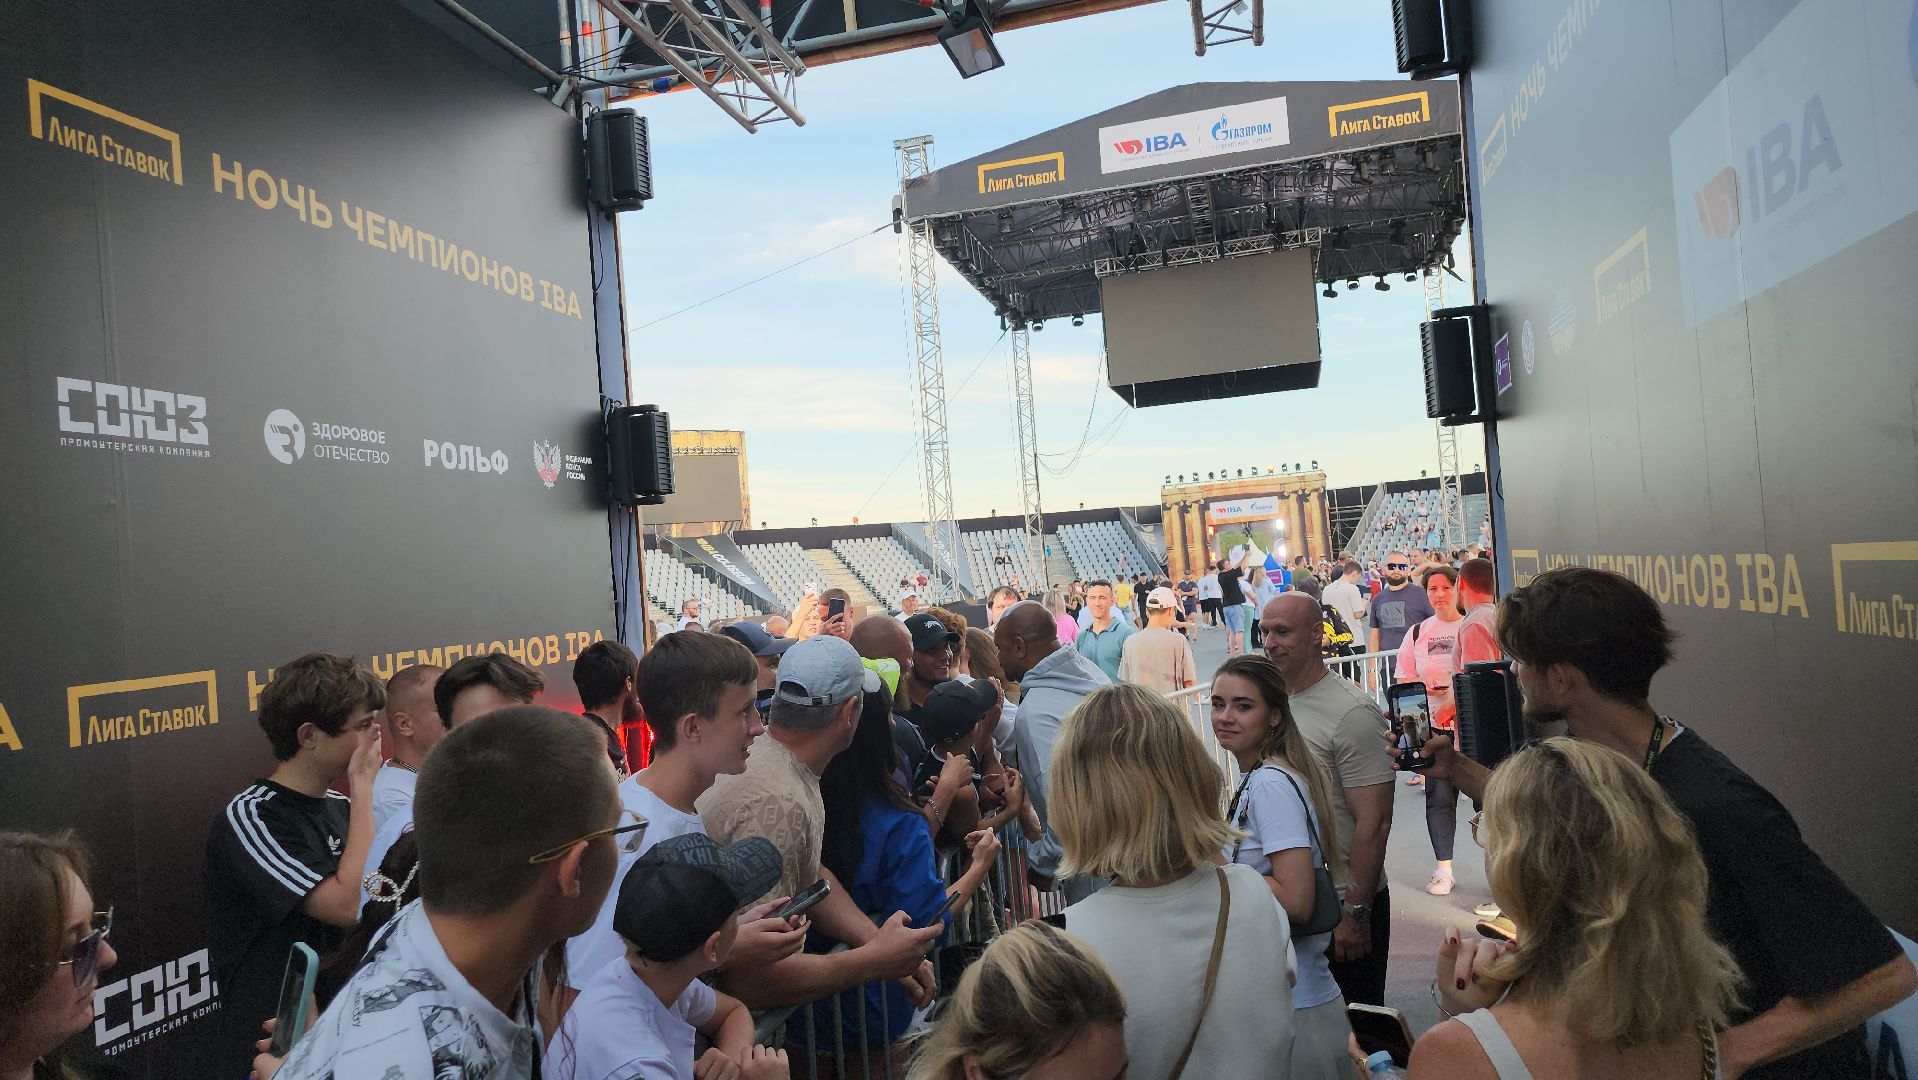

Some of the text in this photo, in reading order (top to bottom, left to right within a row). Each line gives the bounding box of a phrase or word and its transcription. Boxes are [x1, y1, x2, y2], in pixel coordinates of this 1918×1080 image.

[1511, 59, 1546, 137] НОЧЬ
[1145, 132, 1187, 153] IBA
[1229, 122, 1272, 140] ГАЗПРОМ
[1745, 93, 1842, 226] IBA
[211, 152, 583, 320] НОЧЬ ЧЕМПИОНОВ IBA
[56, 376, 209, 446] СОЮЗ
[311, 421, 386, 444] ЗДОРОВОЕ
[313, 444, 390, 465] ОТЕЧЕСТВО
[423, 438, 509, 475] РОЛЬФ
[1735, 553, 1809, 618] IBA
[93, 948, 219, 1047] СОЮ
